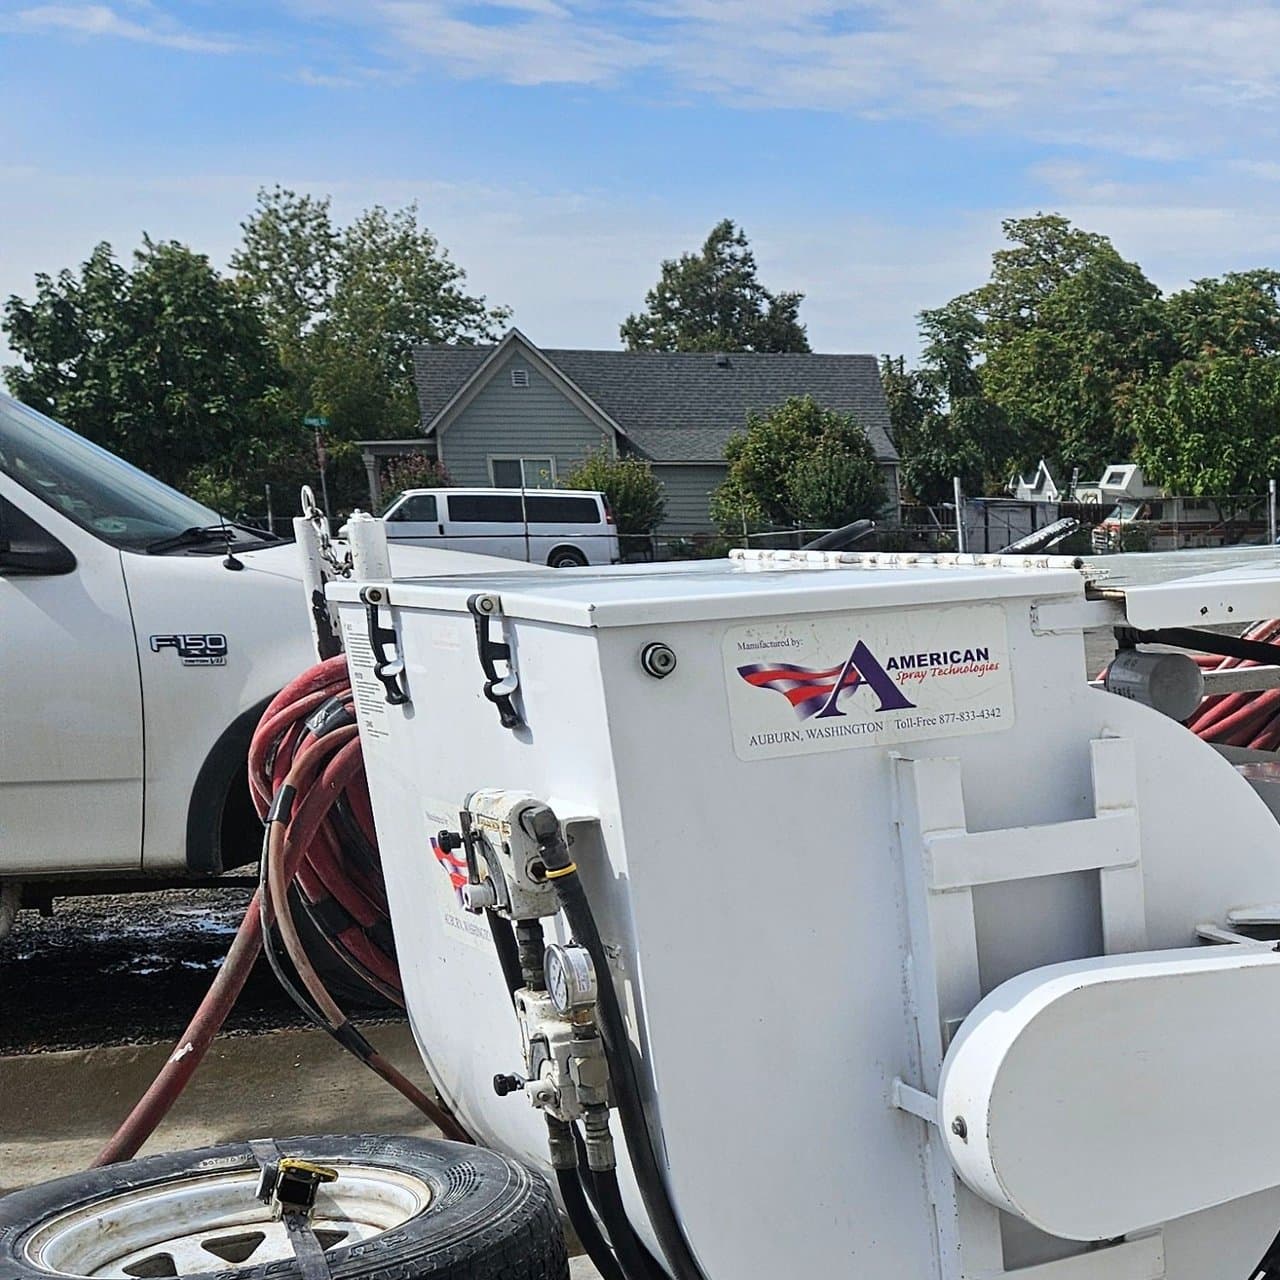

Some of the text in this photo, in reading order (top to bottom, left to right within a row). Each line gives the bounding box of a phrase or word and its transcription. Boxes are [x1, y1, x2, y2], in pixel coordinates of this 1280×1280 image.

[738, 638, 803, 651] Manufactured by:
[886, 648, 989, 671] AMERICAN
[896, 660, 999, 685] Spray Technologies
[895, 708, 1001, 730] Toll-Free 877-833-4342
[750, 721, 884, 746] AUBURN, WASHINGTON
